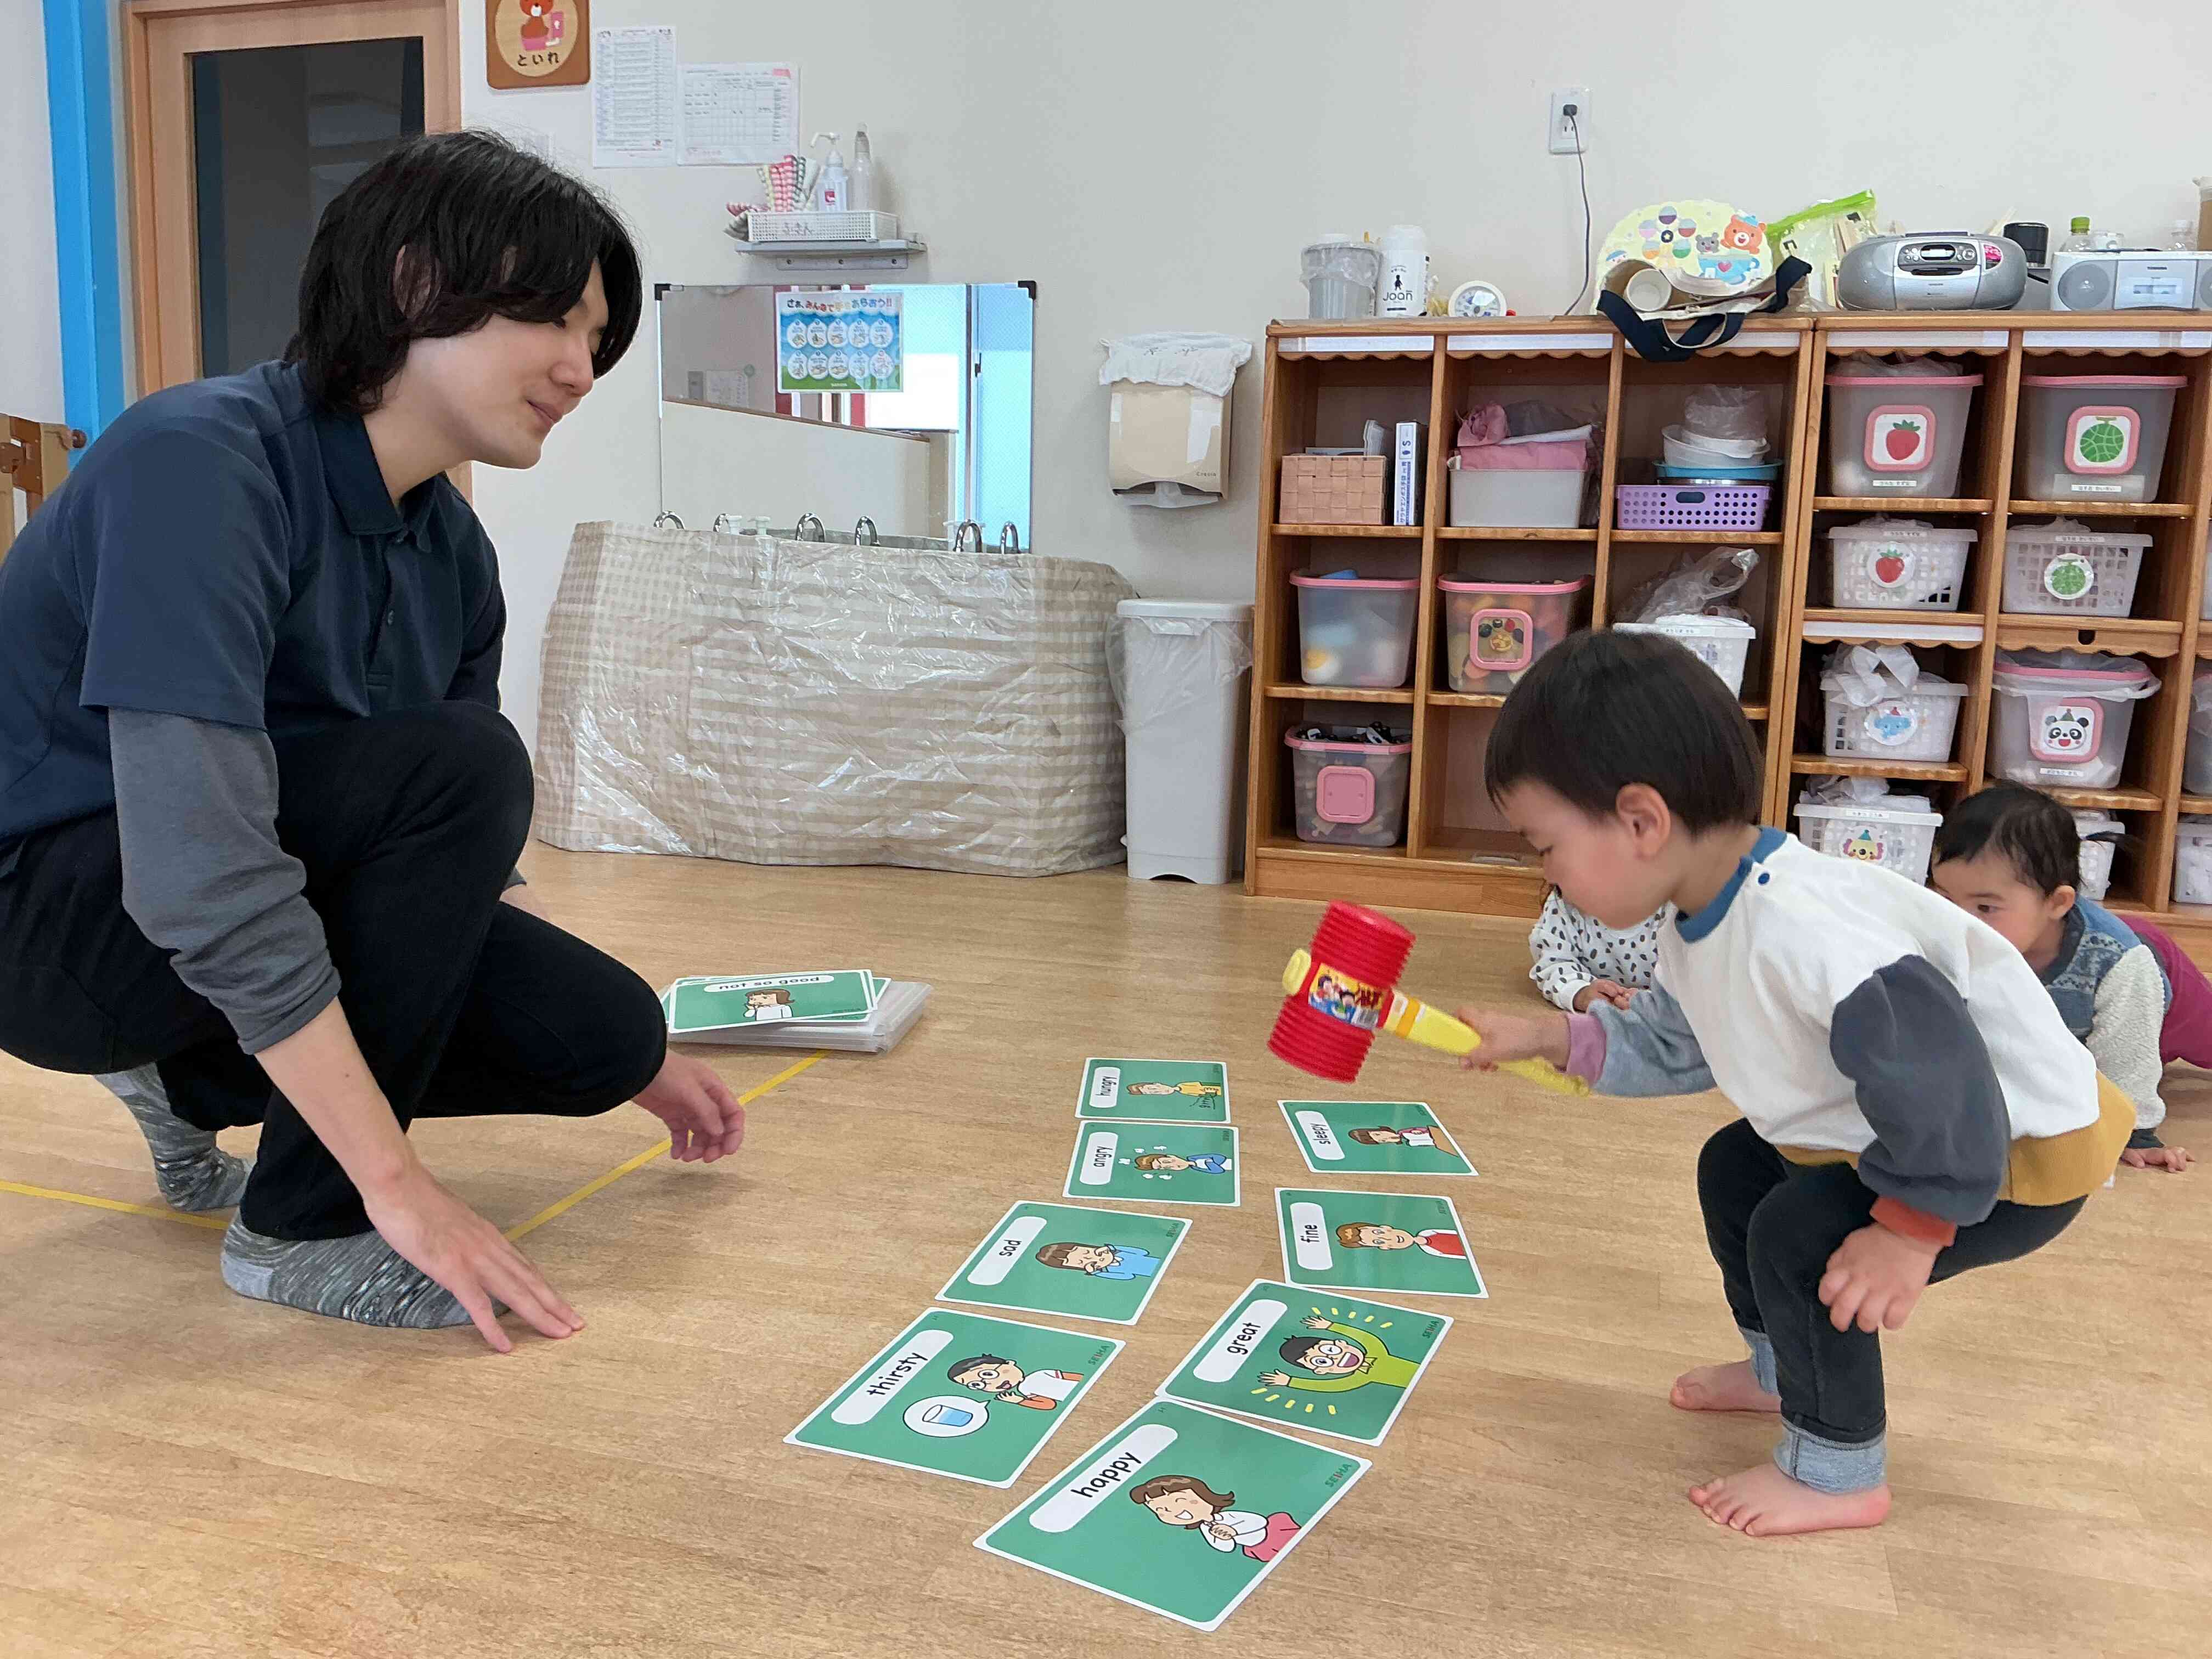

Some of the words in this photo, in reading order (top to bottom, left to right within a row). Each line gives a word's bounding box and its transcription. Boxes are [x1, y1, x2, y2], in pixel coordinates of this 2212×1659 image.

[517, 52, 560, 66] といれ
[778, 977, 820, 985] good
[1096, 1075, 1117, 1096] hungry
[1310, 1123, 1331, 1144] sleepy
[1093, 1146, 1113, 1167] angry
[1301, 1224, 1318, 1243] fine
[998, 1239, 1022, 1257] sad
[1227, 1322, 1262, 1356] great
[1422, 1320, 1440, 1339] SEIHA
[1088, 1345, 1109, 1365] SEIHA
[866, 1351, 929, 1396] thirsty
[1070, 1451, 1143, 1499] happy
[1324, 1463, 1352, 1487] SEIHA
